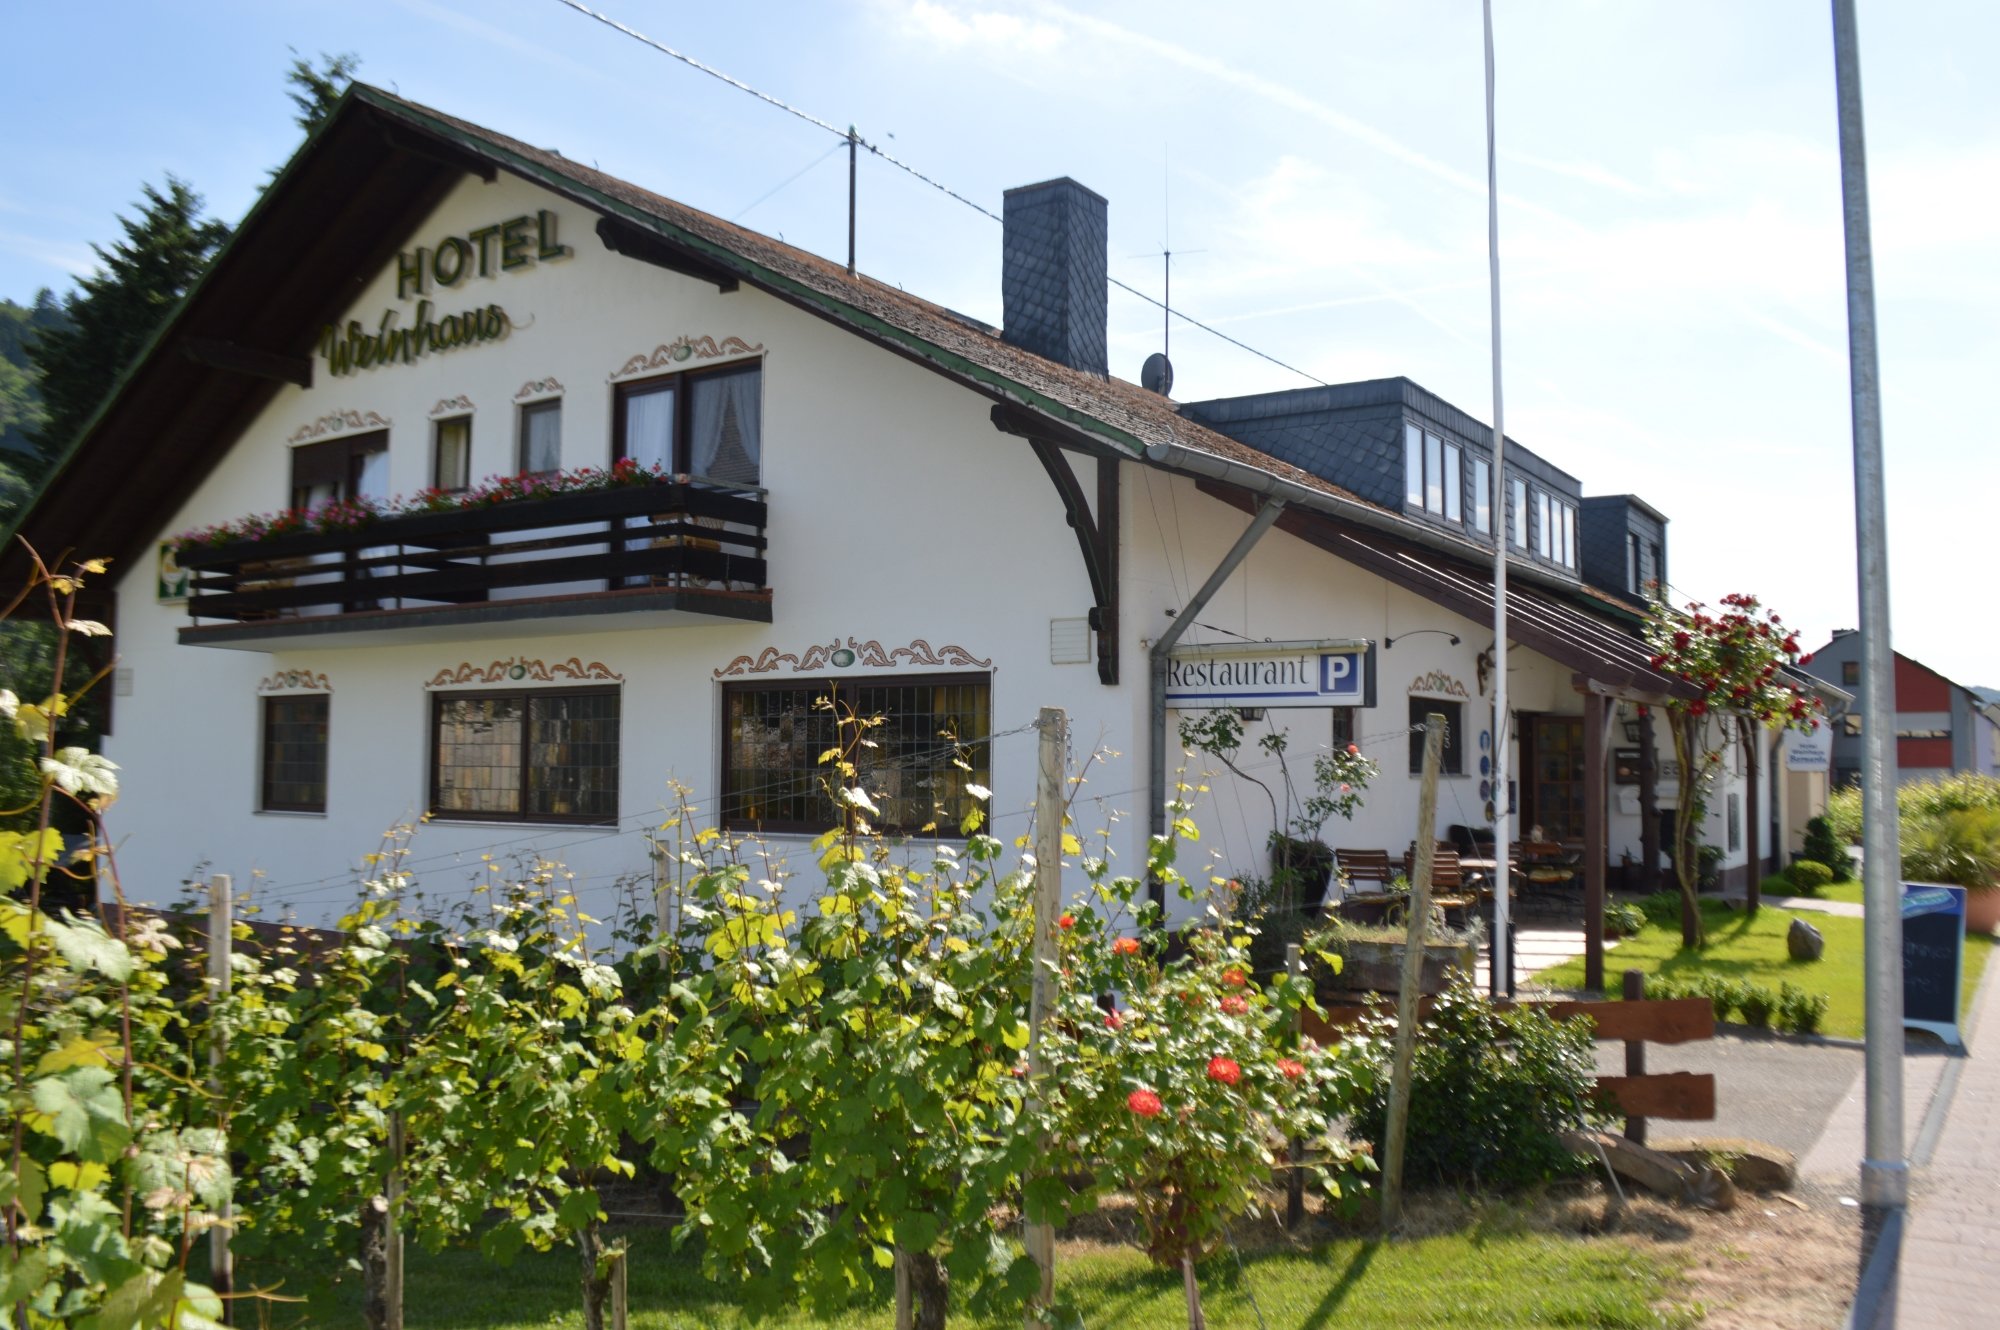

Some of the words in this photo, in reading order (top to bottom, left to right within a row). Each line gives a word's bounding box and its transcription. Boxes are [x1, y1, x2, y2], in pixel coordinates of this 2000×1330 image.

[397, 208, 574, 300] HOTEL
[319, 299, 518, 377] Weinhaus
[1166, 655, 1310, 688] Restaurant
[1327, 656, 1351, 690] P
